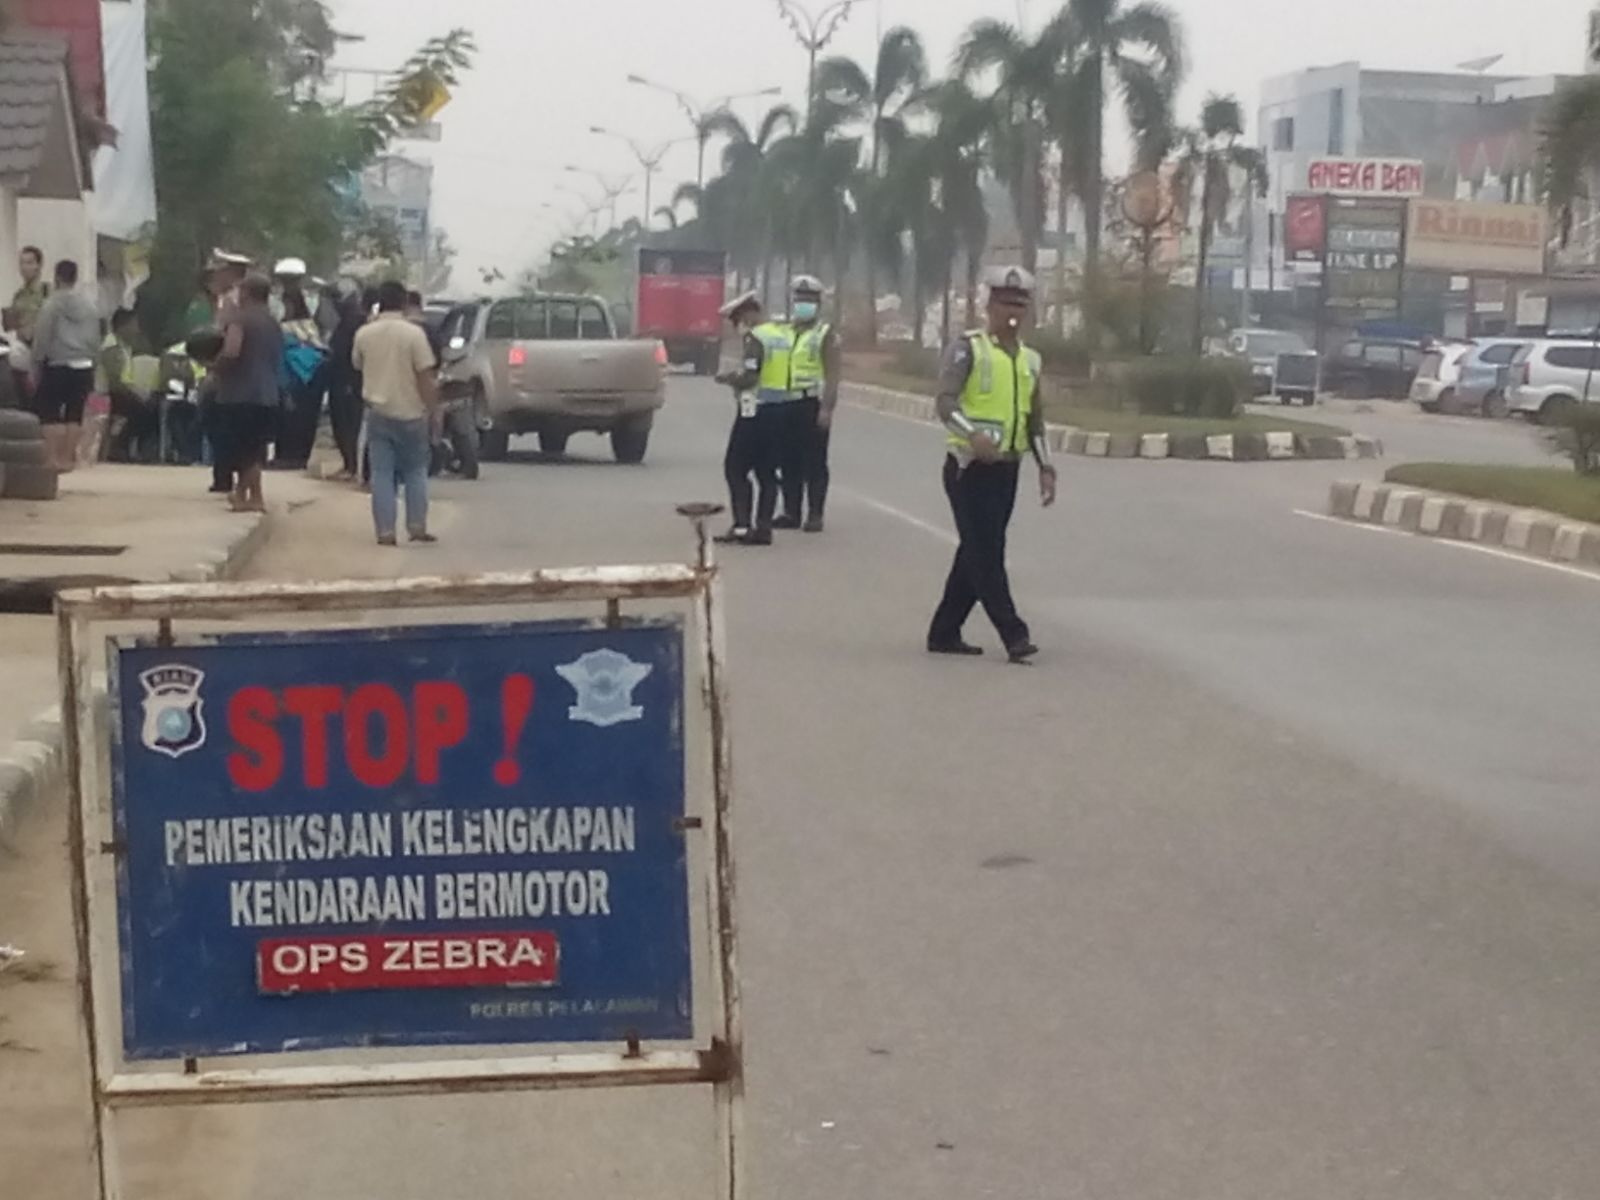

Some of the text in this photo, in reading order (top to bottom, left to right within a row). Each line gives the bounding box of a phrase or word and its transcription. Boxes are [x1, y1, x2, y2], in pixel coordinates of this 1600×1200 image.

[1308, 161, 1420, 192] ANEKA BAN
[1416, 206, 1540, 242] Rinnai
[228, 683, 468, 791] STOP
[165, 808, 636, 865] PEMERIKSAAN KELENGKAPAN
[231, 870, 611, 926] KENDARAAN BERMOTOR
[271, 938, 543, 975] OPS ZEBRA
